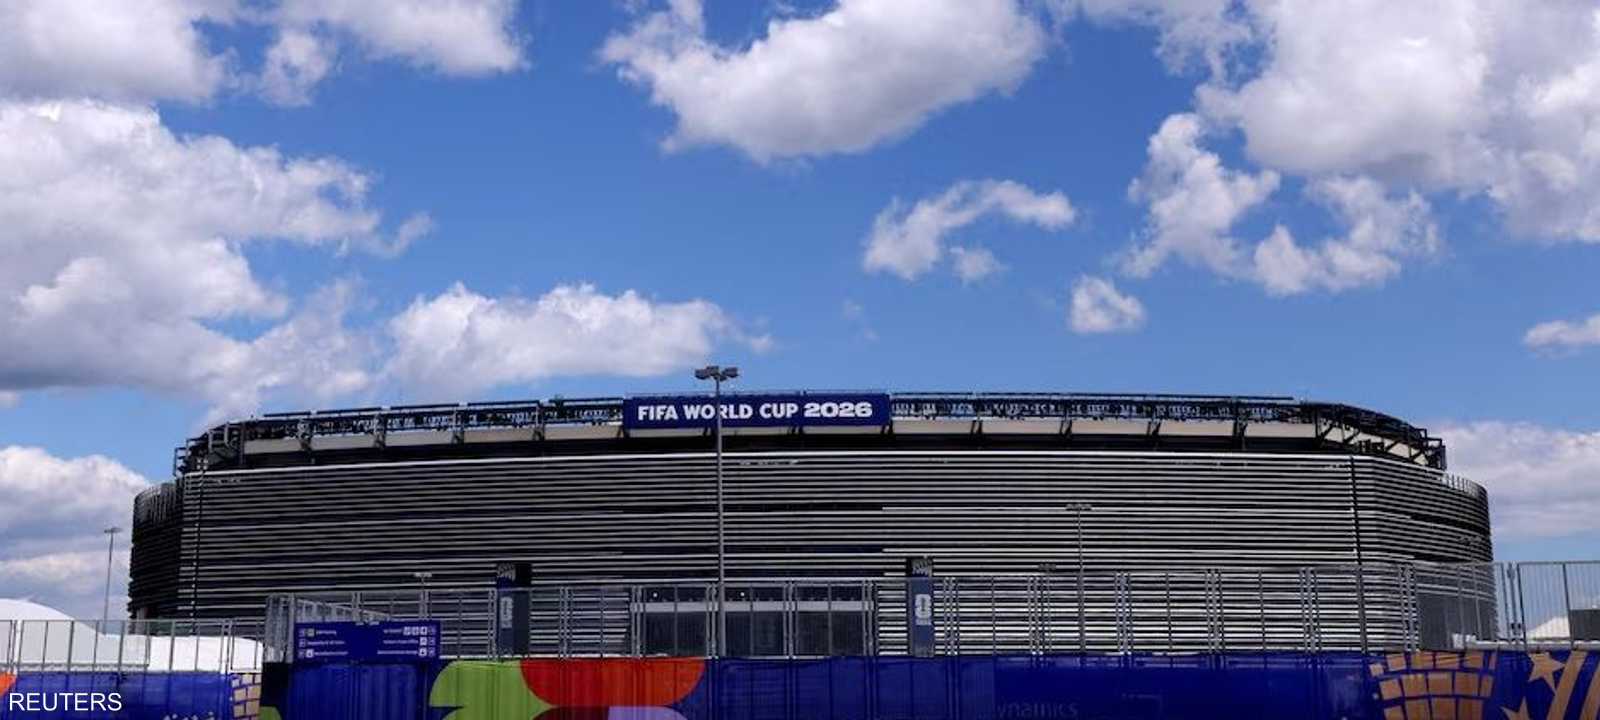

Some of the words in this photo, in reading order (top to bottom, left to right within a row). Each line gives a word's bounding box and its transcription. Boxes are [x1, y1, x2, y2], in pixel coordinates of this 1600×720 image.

[637, 404, 679, 421] FIFA
[683, 403, 753, 420] WORLD
[758, 402, 799, 418] CUP
[803, 401, 873, 418] 2026
